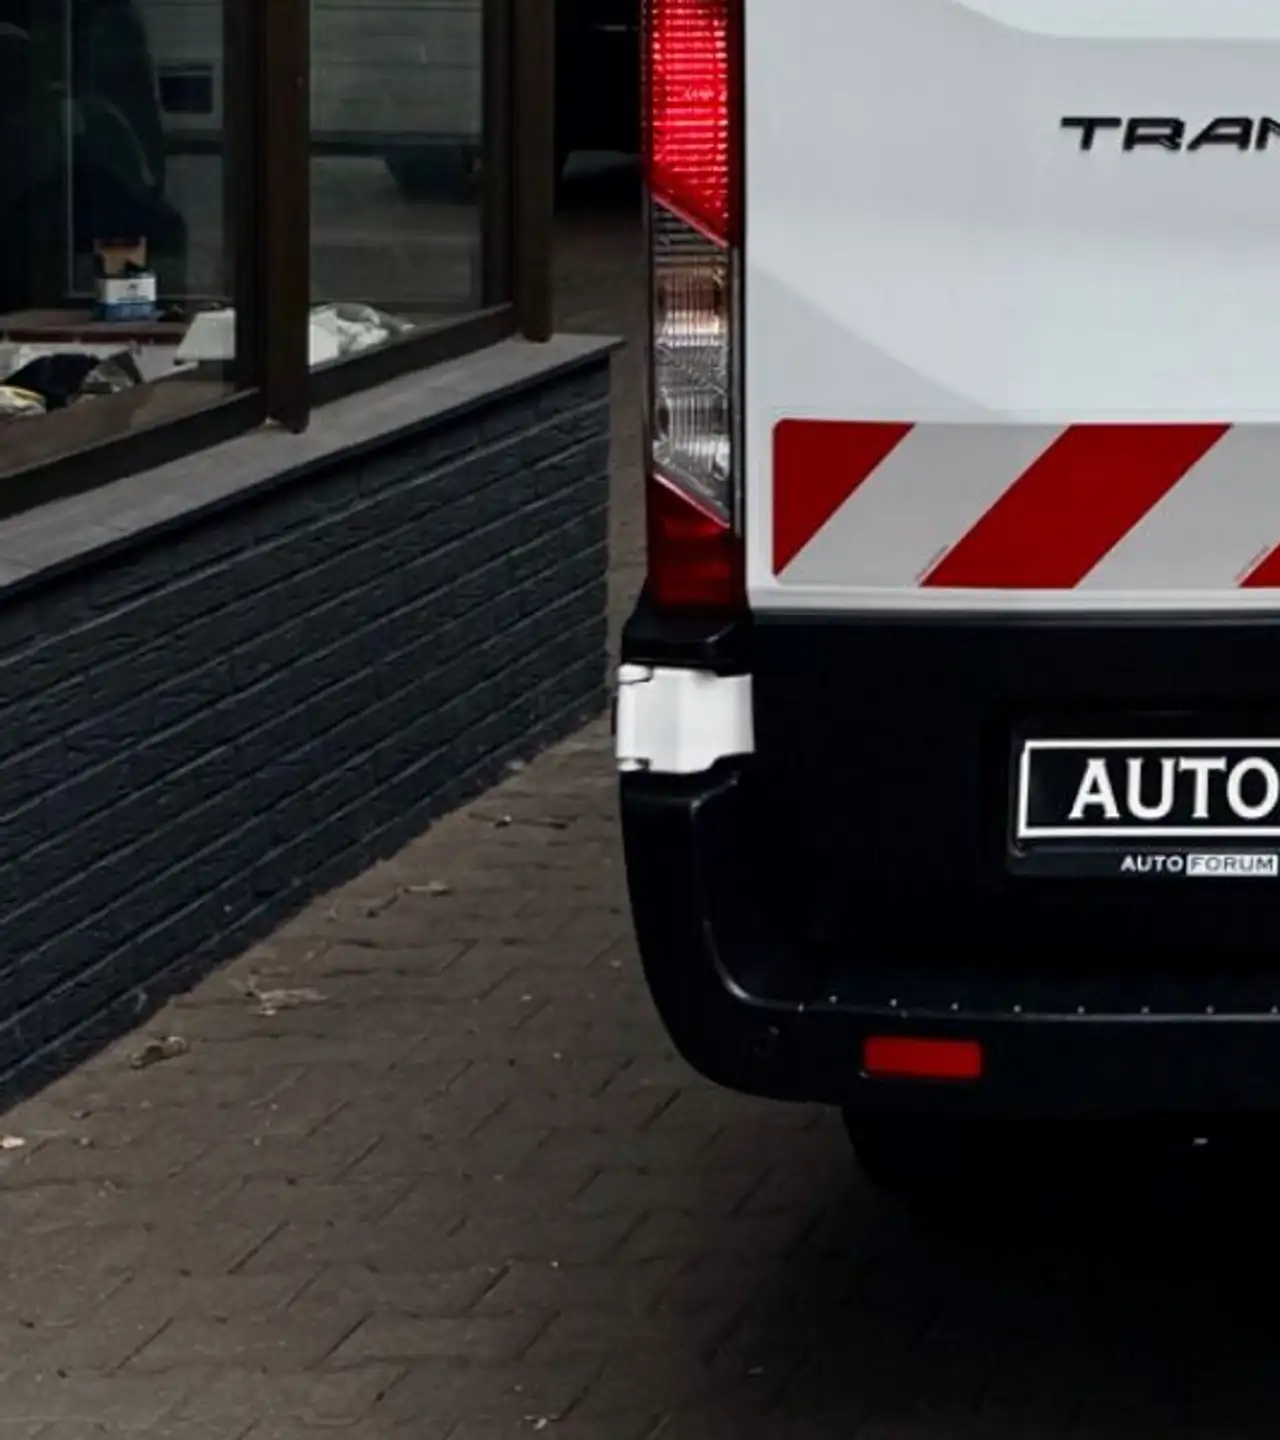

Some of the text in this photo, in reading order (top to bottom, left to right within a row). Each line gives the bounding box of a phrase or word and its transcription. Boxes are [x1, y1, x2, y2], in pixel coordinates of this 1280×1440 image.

[1068, 756, 1280, 820] AUTO
[1120, 854, 1184, 872] AUTO
[1190, 855, 1276, 872] FORUM
